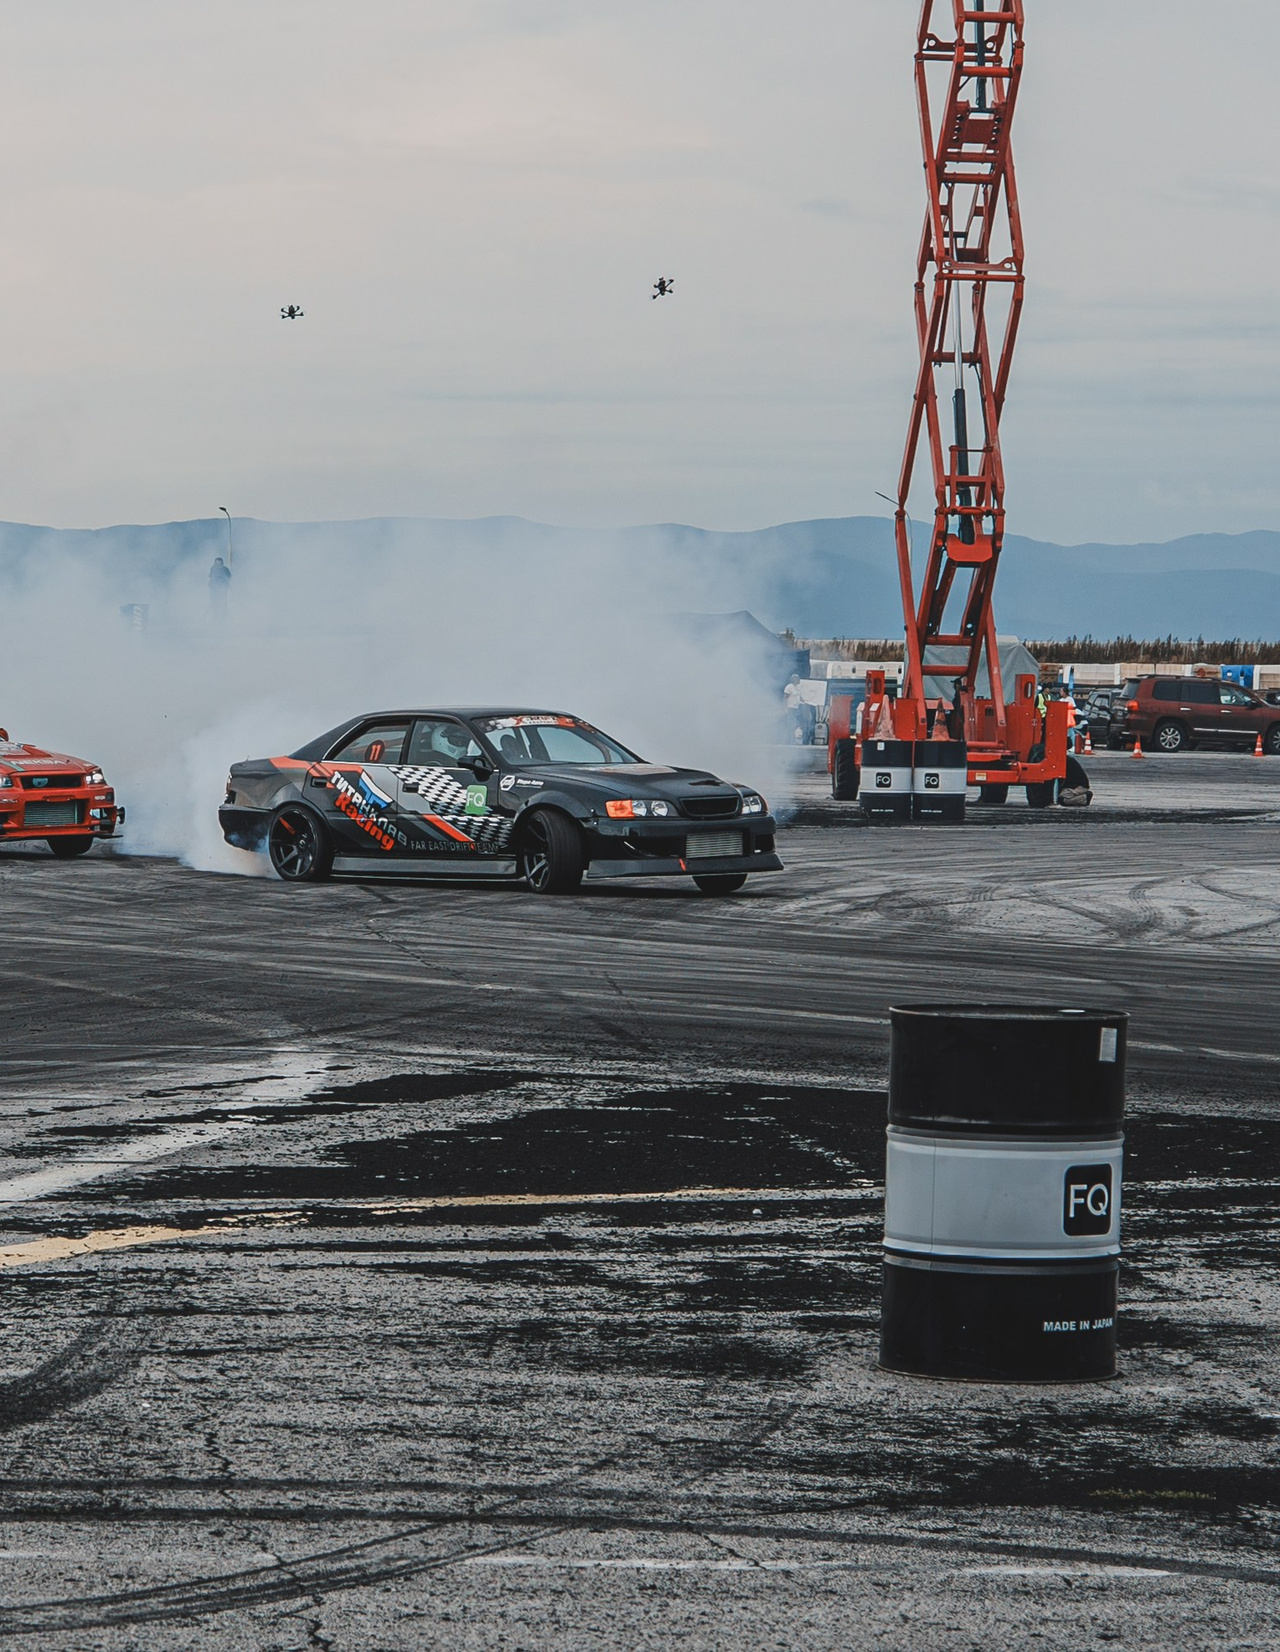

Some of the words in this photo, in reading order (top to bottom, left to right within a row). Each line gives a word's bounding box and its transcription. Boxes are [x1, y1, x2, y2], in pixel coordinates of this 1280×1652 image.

[370, 744, 382, 761] 11
[877, 776, 890, 784] FQ
[926, 777, 938, 785] FQ
[466, 791, 486, 807] FQ
[335, 791, 395, 851] Racing
[411, 840, 426, 850] FAR
[429, 840, 448, 852] EAST
[1068, 1182, 1110, 1218] FQ
[1043, 1321, 1077, 1332] MADE
[1079, 1320, 1091, 1331] IN
[1092, 1317, 1114, 1330] JAPAN
